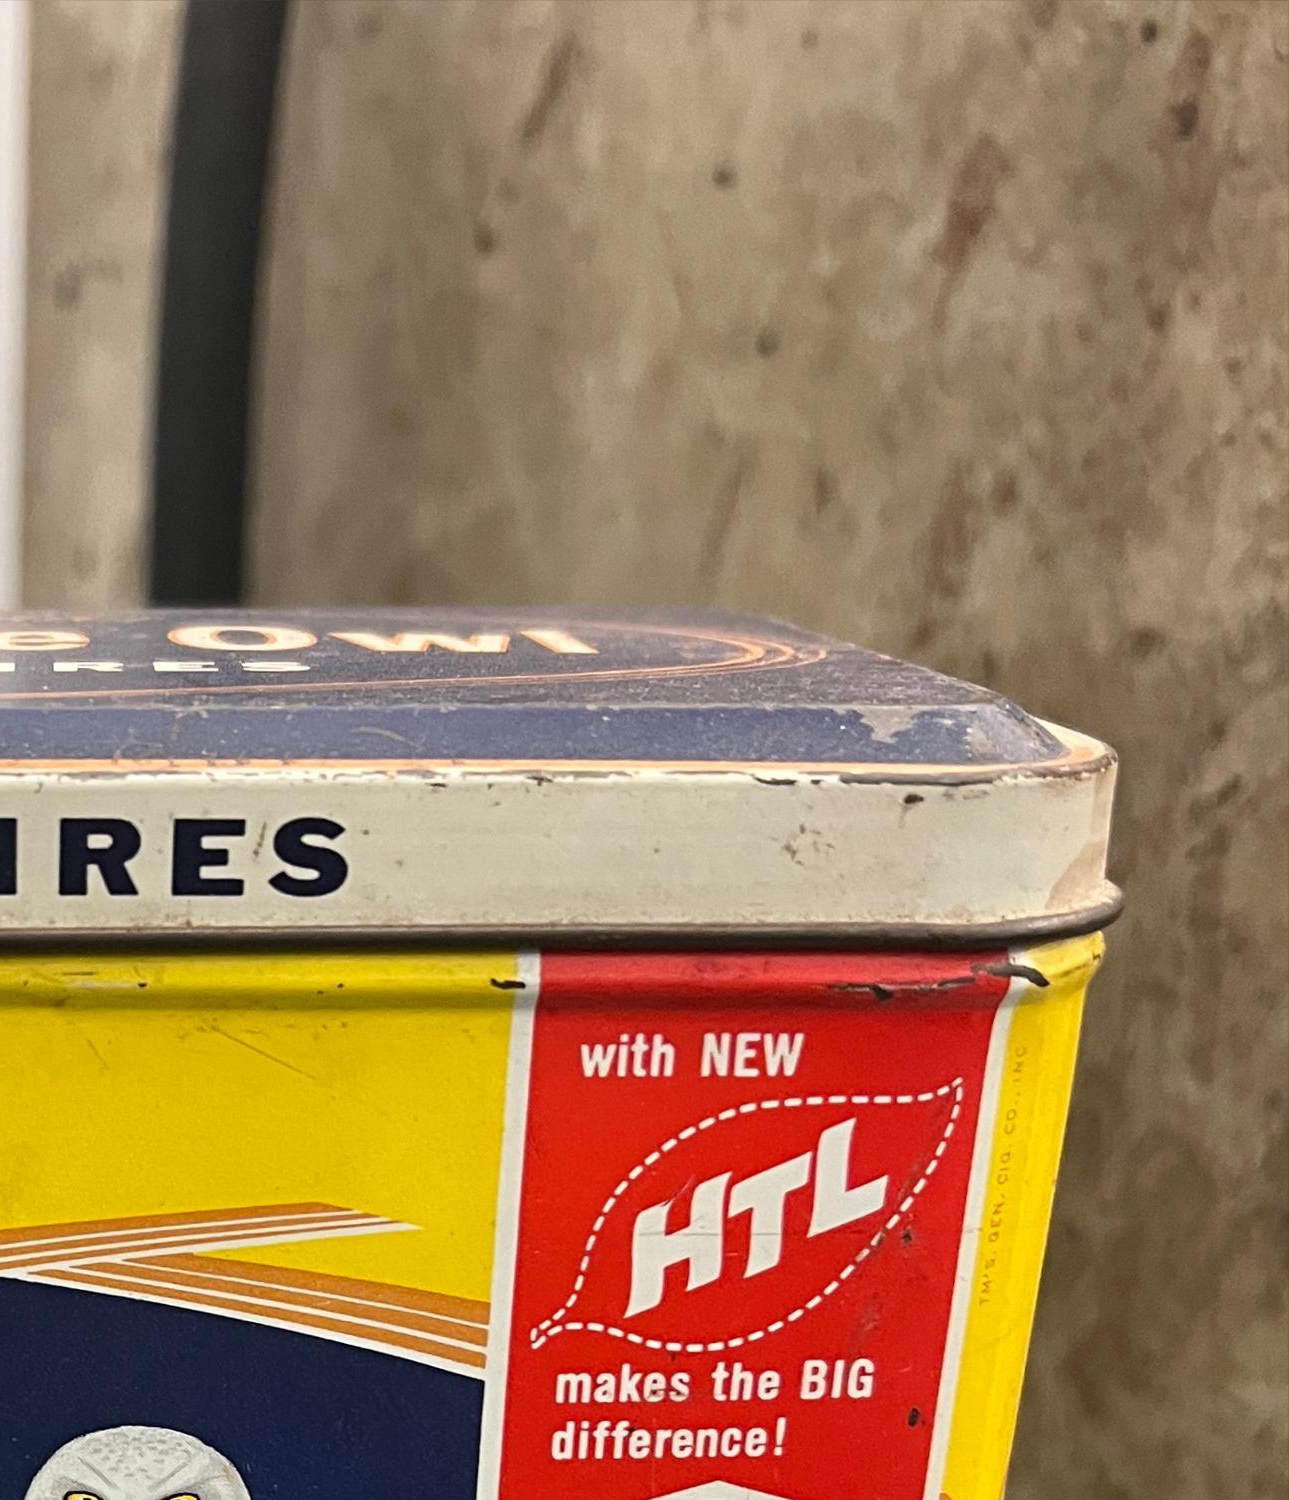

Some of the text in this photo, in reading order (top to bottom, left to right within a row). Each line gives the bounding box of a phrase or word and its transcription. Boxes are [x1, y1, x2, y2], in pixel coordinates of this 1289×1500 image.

[167, 625, 599, 655] Owl
[579, 1032, 805, 1078] with NEW
[622, 1116, 889, 1320] HTL
[554, 1357, 876, 1405] makes the BIG
[550, 1416, 788, 1461] difference!
